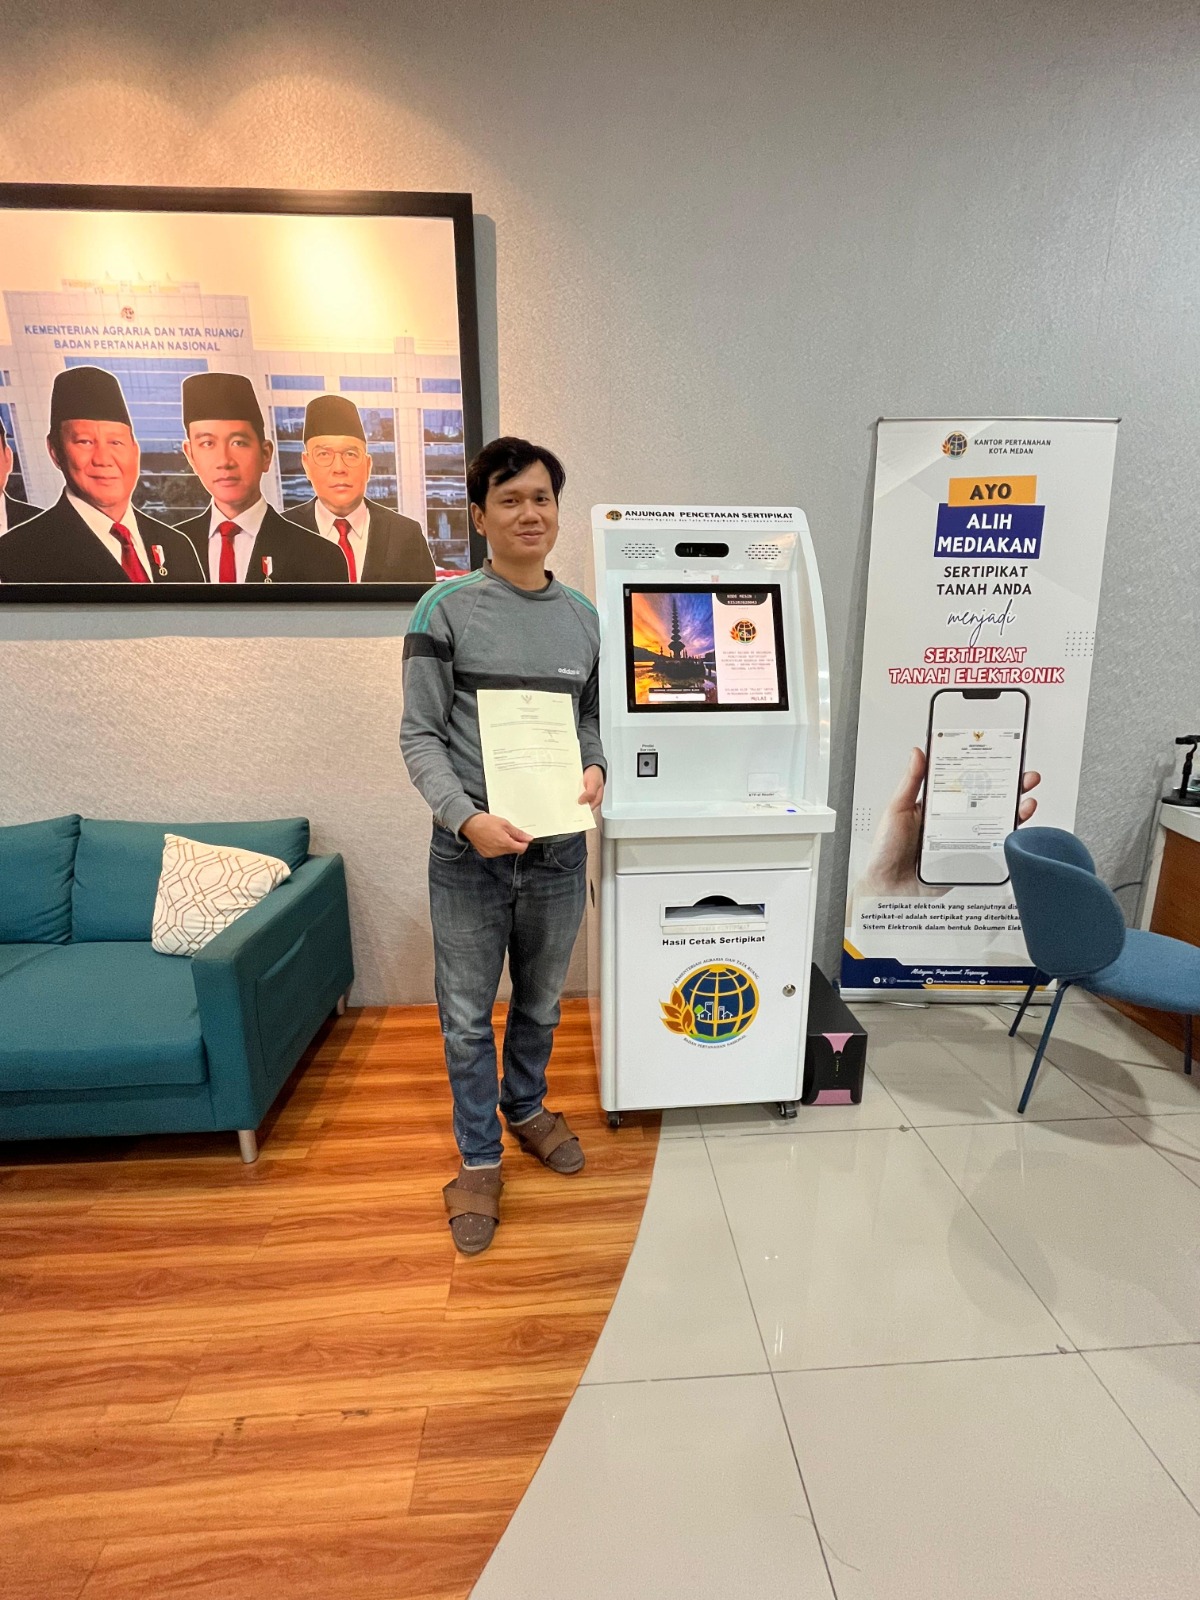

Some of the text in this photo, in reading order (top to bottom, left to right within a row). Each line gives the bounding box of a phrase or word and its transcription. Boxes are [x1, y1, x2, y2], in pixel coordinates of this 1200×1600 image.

[25, 325, 243, 338] KEMENTERIAN AGRARIA DAN TATA RUANG/
[54, 340, 220, 351] BADAN PERTANAHAN NASIONAL
[969, 483, 1012, 500] AYO
[966, 513, 1012, 530] ALIH
[937, 536, 1036, 554] MEDIAKAN
[944, 566, 1028, 578] SERTIPIKAT
[936, 583, 1032, 595] TANAH ANDA
[947, 599, 1016, 648] menjadi
[924, 647, 1027, 663] SERTIPIKAT
[889, 667, 1065, 684] TANAH ELEKTRONIK
[720, 936, 765, 944] Sertipikat
[674, 961, 701, 984] KEMENTERIAN
[737, 960, 747, 968] TATA
[748, 965, 759, 979] RUANG
